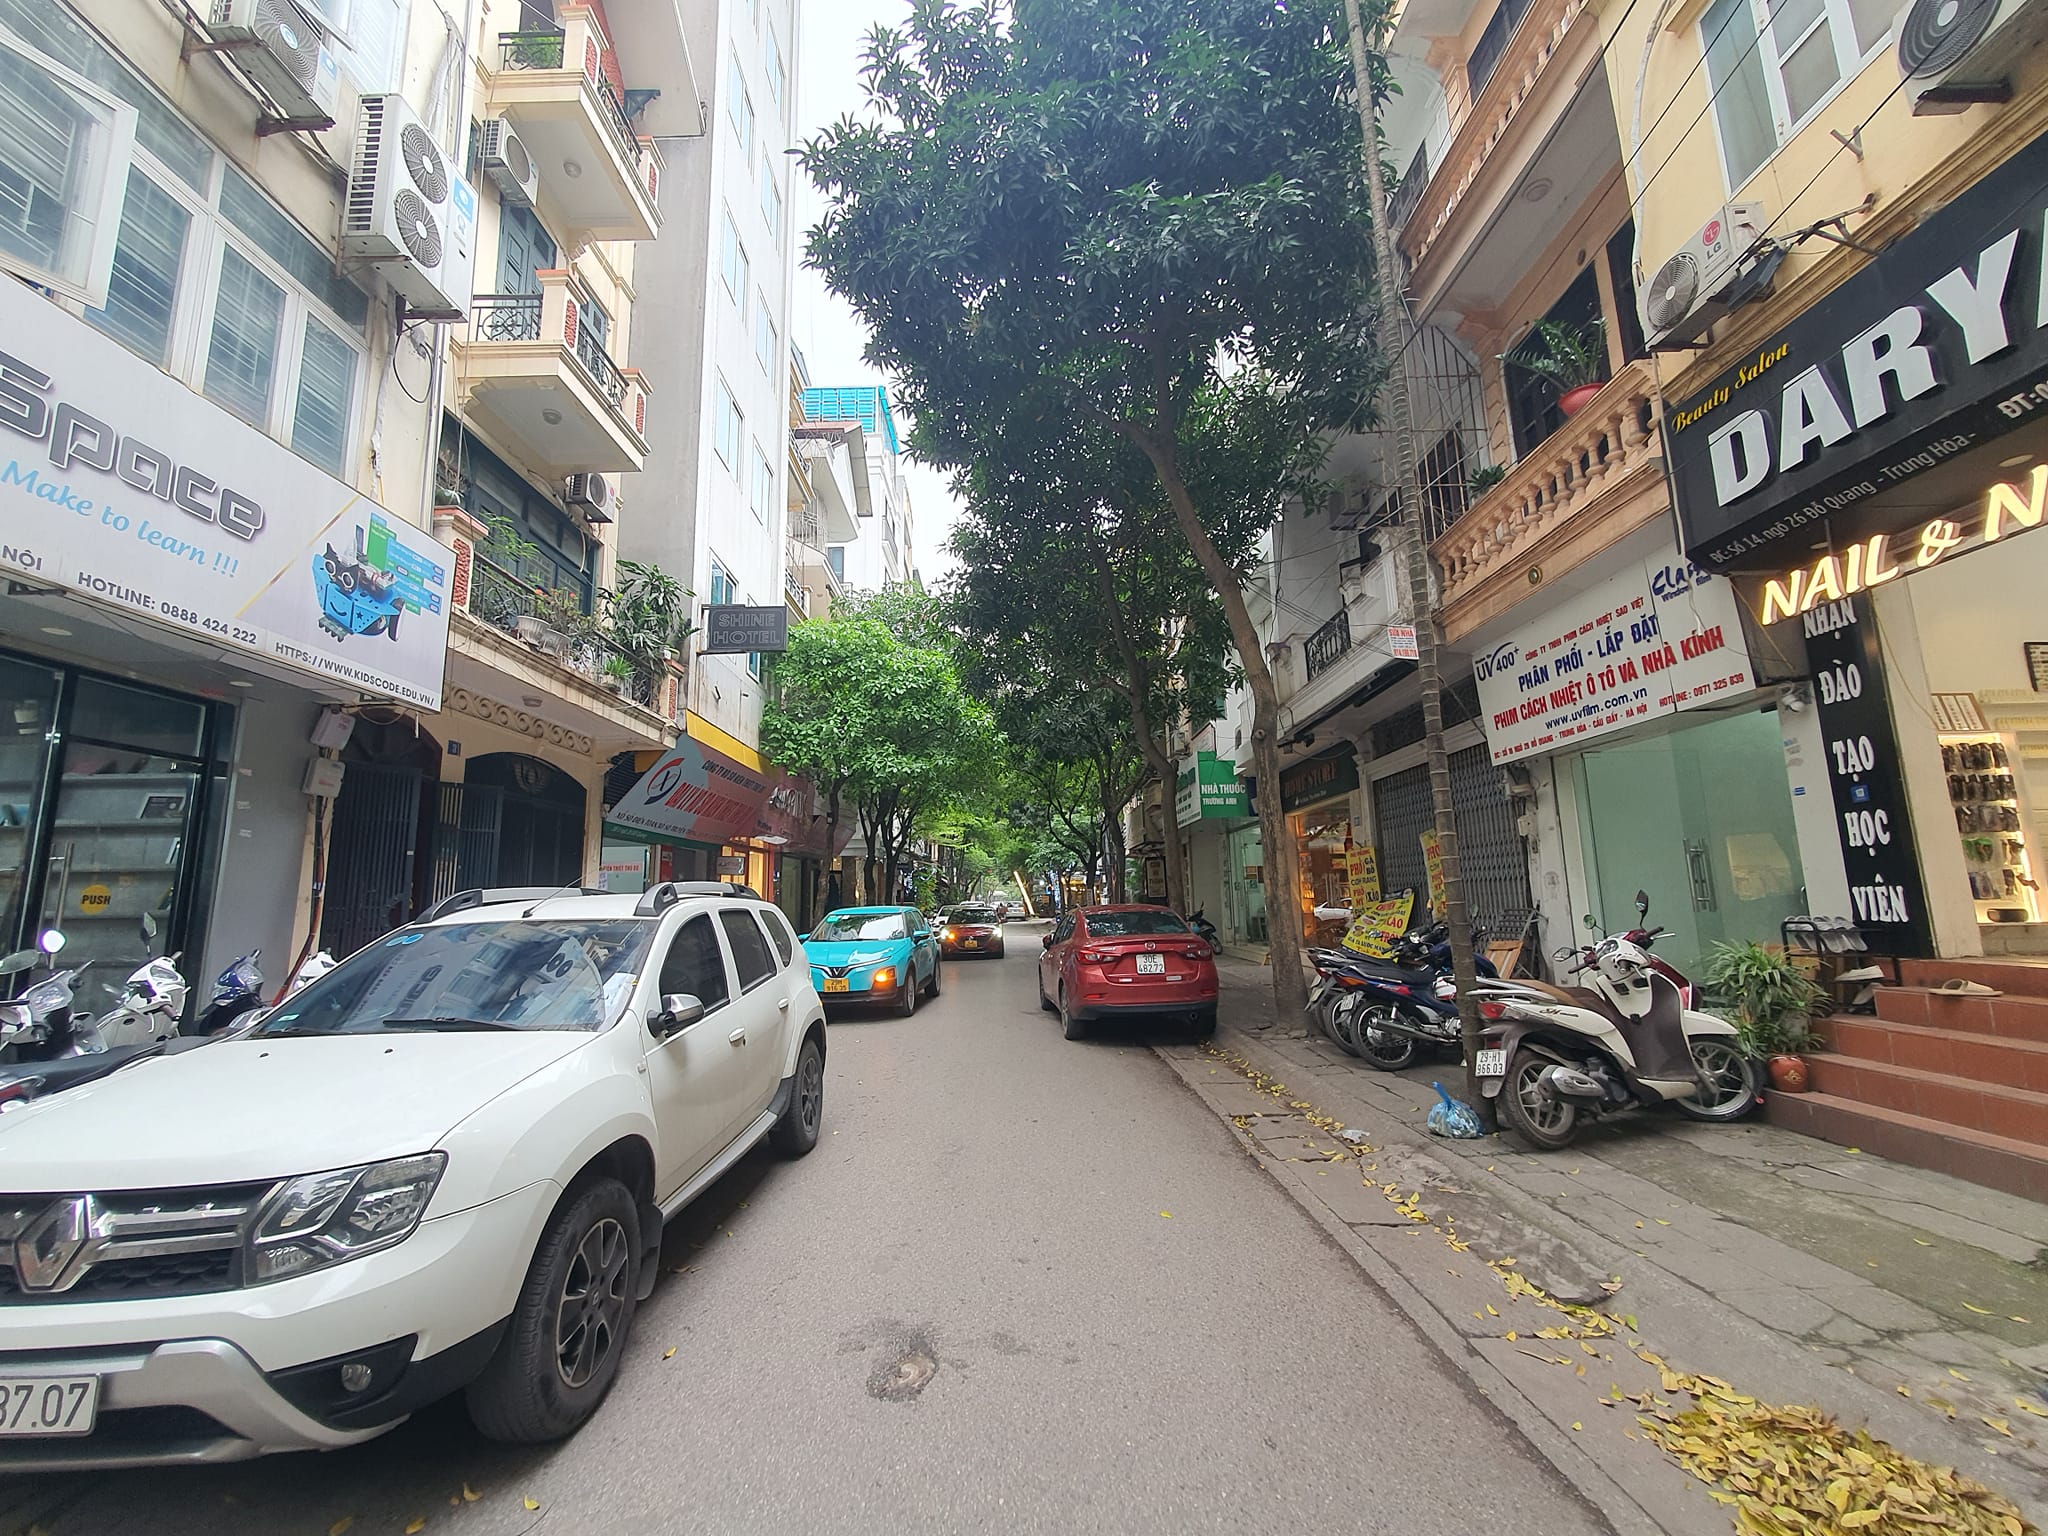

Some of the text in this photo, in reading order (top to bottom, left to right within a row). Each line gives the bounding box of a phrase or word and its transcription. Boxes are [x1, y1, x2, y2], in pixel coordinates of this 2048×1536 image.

[1707, 242, 1722, 260] LG
[1708, 208, 2048, 507] DARY
[1671, 341, 1789, 434] Beauty Salon
[1763, 519, 1789, 543] ngõ
[1789, 512, 1807, 529] 26
[1803, 501, 1826, 520] Đỗ
[1823, 479, 1877, 511] Quang
[1879, 453, 1936, 483] Trung
[1934, 433, 1968, 456] Hòa
[1, 460, 239, 578] Make to learn !!!
[2, 544, 43, 571] NỘI
[1761, 533, 1899, 626] NAIL
[1916, 519, 1963, 568] &
[78, 572, 258, 645] HOTLINE: 0888 424 222
[718, 612, 776, 628] SHINE
[1563, 630, 1577, 644] PHIM
[1615, 605, 1628, 618] SAO
[713, 630, 781, 645] HOTEL
[1518, 664, 1550, 692] PHÂN
[1554, 642, 1584, 677] PHỐI
[1596, 625, 1624, 658] LẮP
[1630, 613, 1659, 645] ĐẶT
[275, 642, 434, 706] HTTPS://WWW.KIDSCODE.EDU.VN/
[1494, 625, 1725, 730] PHIM CÁCH NHIỆT Ô TÔ VÀ NHÀ KÍNH
[1693, 682, 1711, 697] 0971
[1712, 678, 1728, 691] 325
[1729, 673, 1744, 686] 839
[1818, 659, 1862, 705] ĐÀO
[1832, 735, 1875, 782] TẠO
[1201, 781, 1246, 795] NHÀ THUỐC
[1844, 809, 1891, 857] HỌC
[80, 893, 112, 907] PUSH
[1852, 874, 1909, 923] VIÊN
[1143, 954, 1157, 963] 30E
